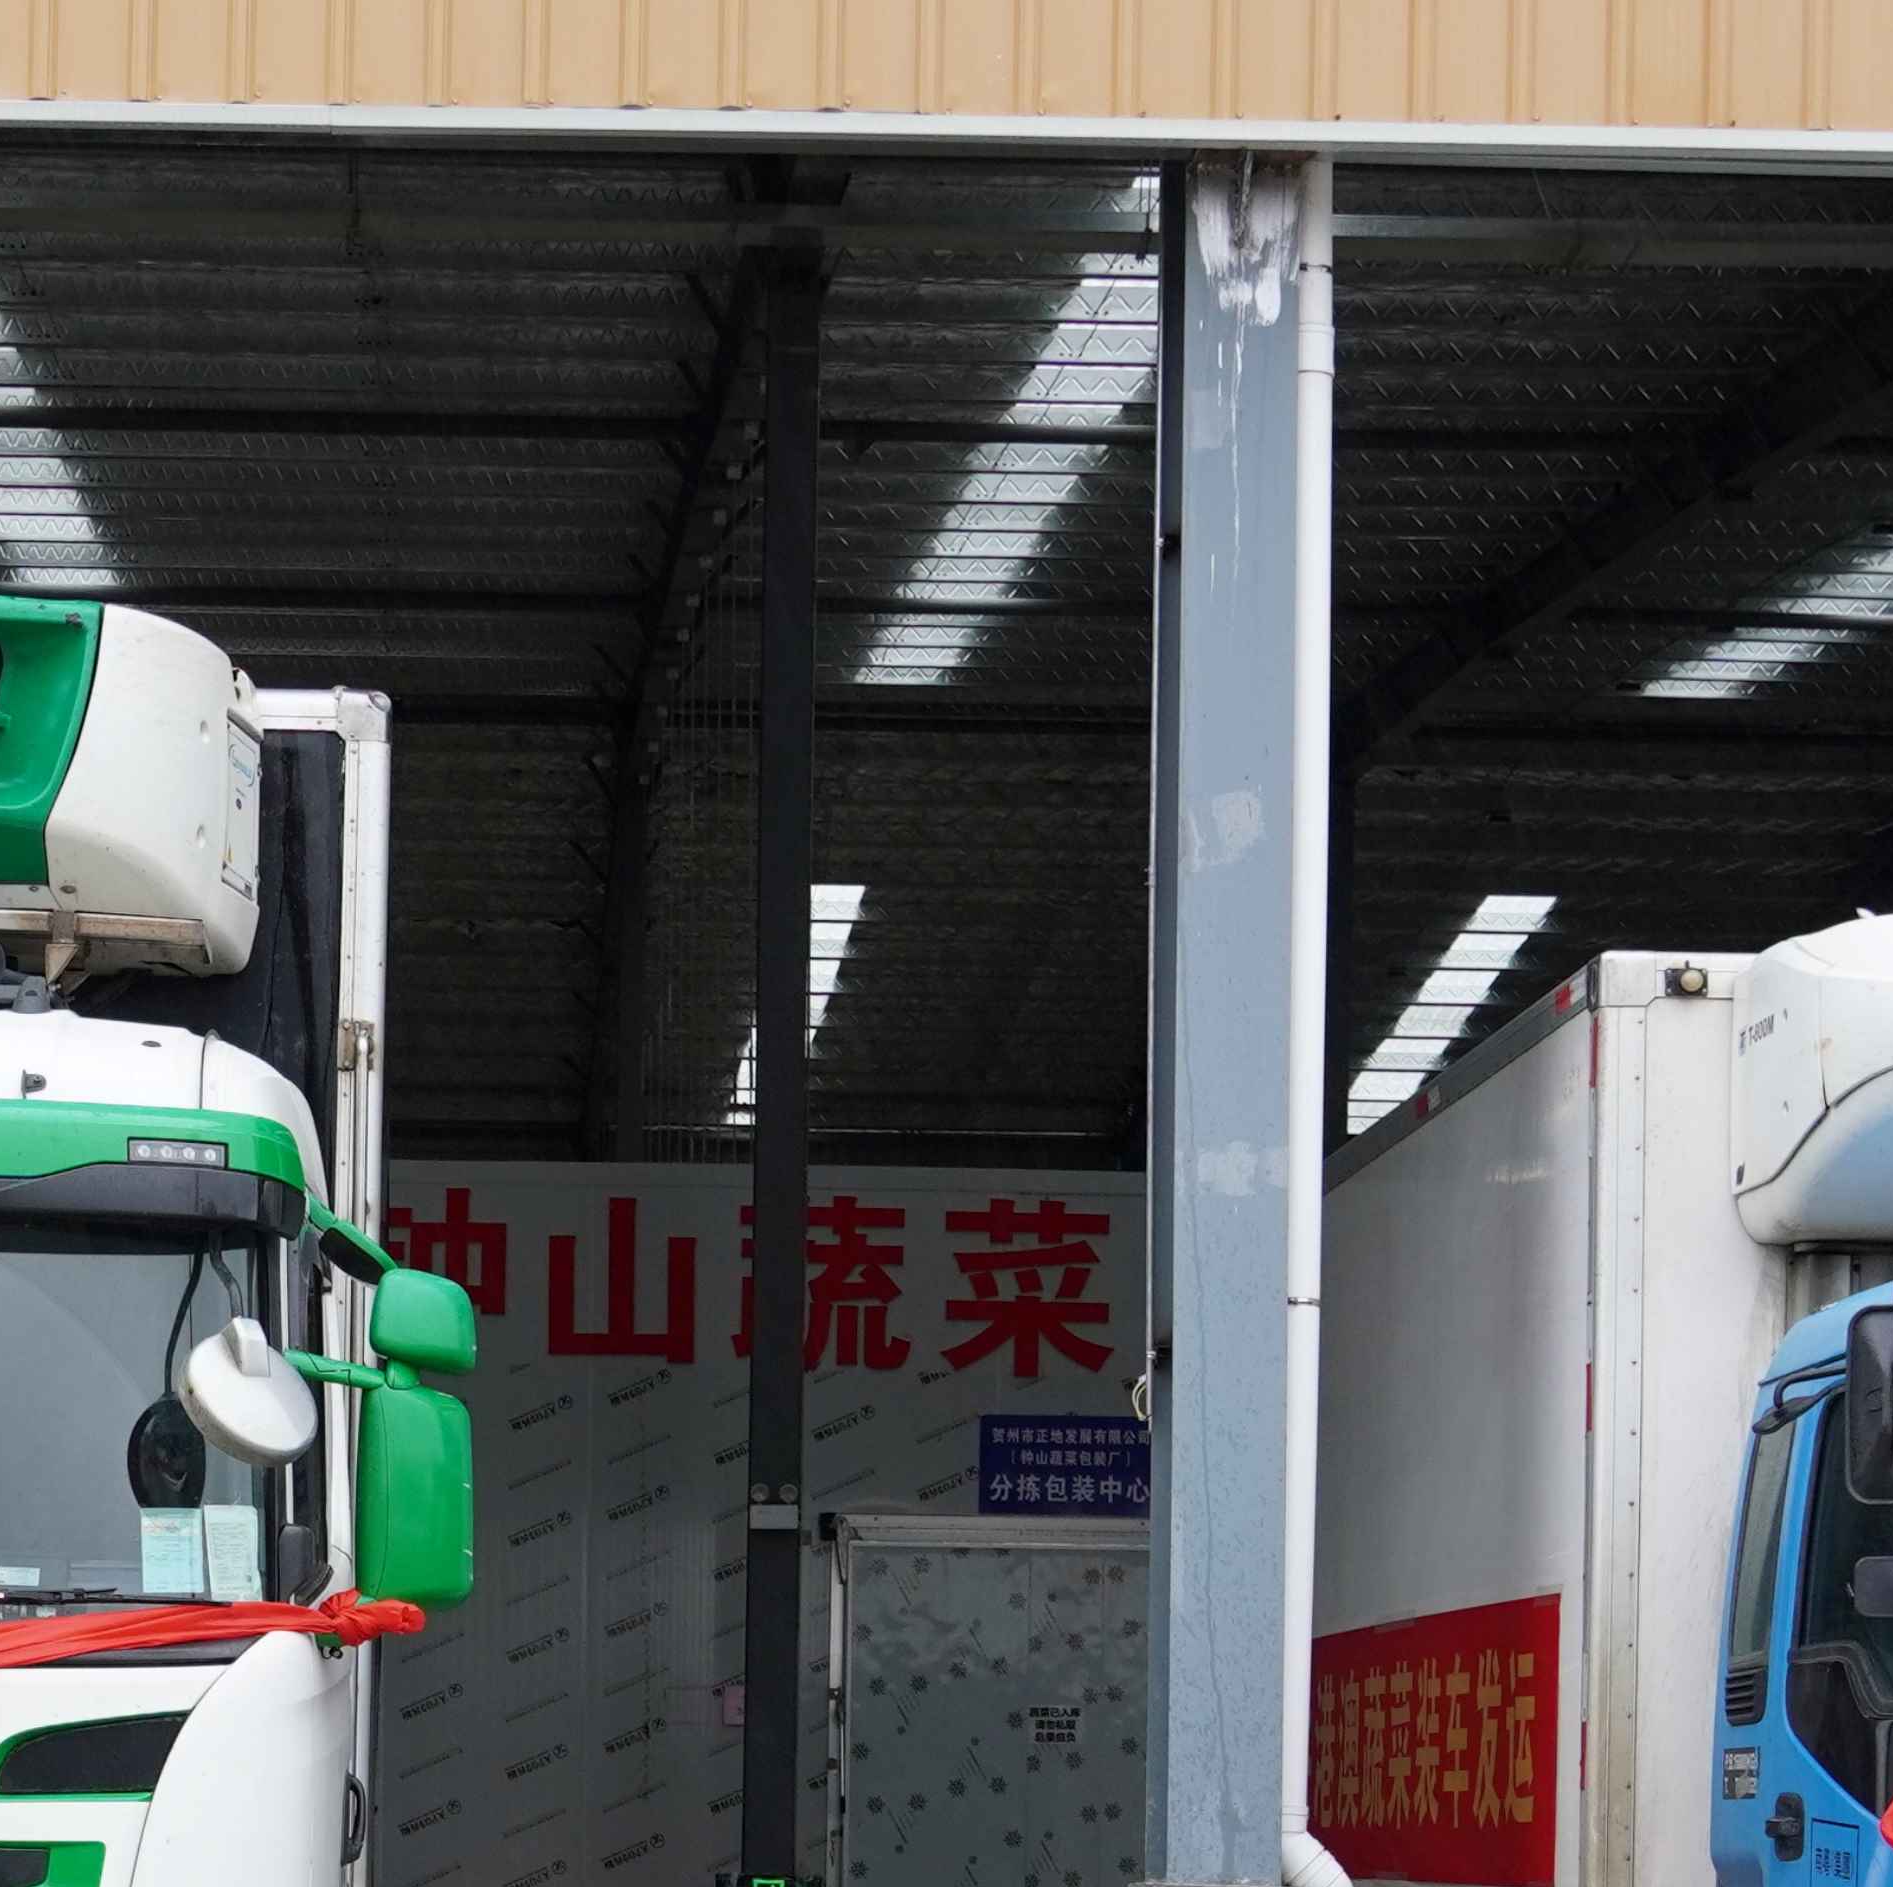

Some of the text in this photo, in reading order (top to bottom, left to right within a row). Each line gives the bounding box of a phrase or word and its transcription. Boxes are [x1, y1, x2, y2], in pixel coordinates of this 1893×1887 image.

[989, 1473, 1151, 1504] 分拣包装中心
